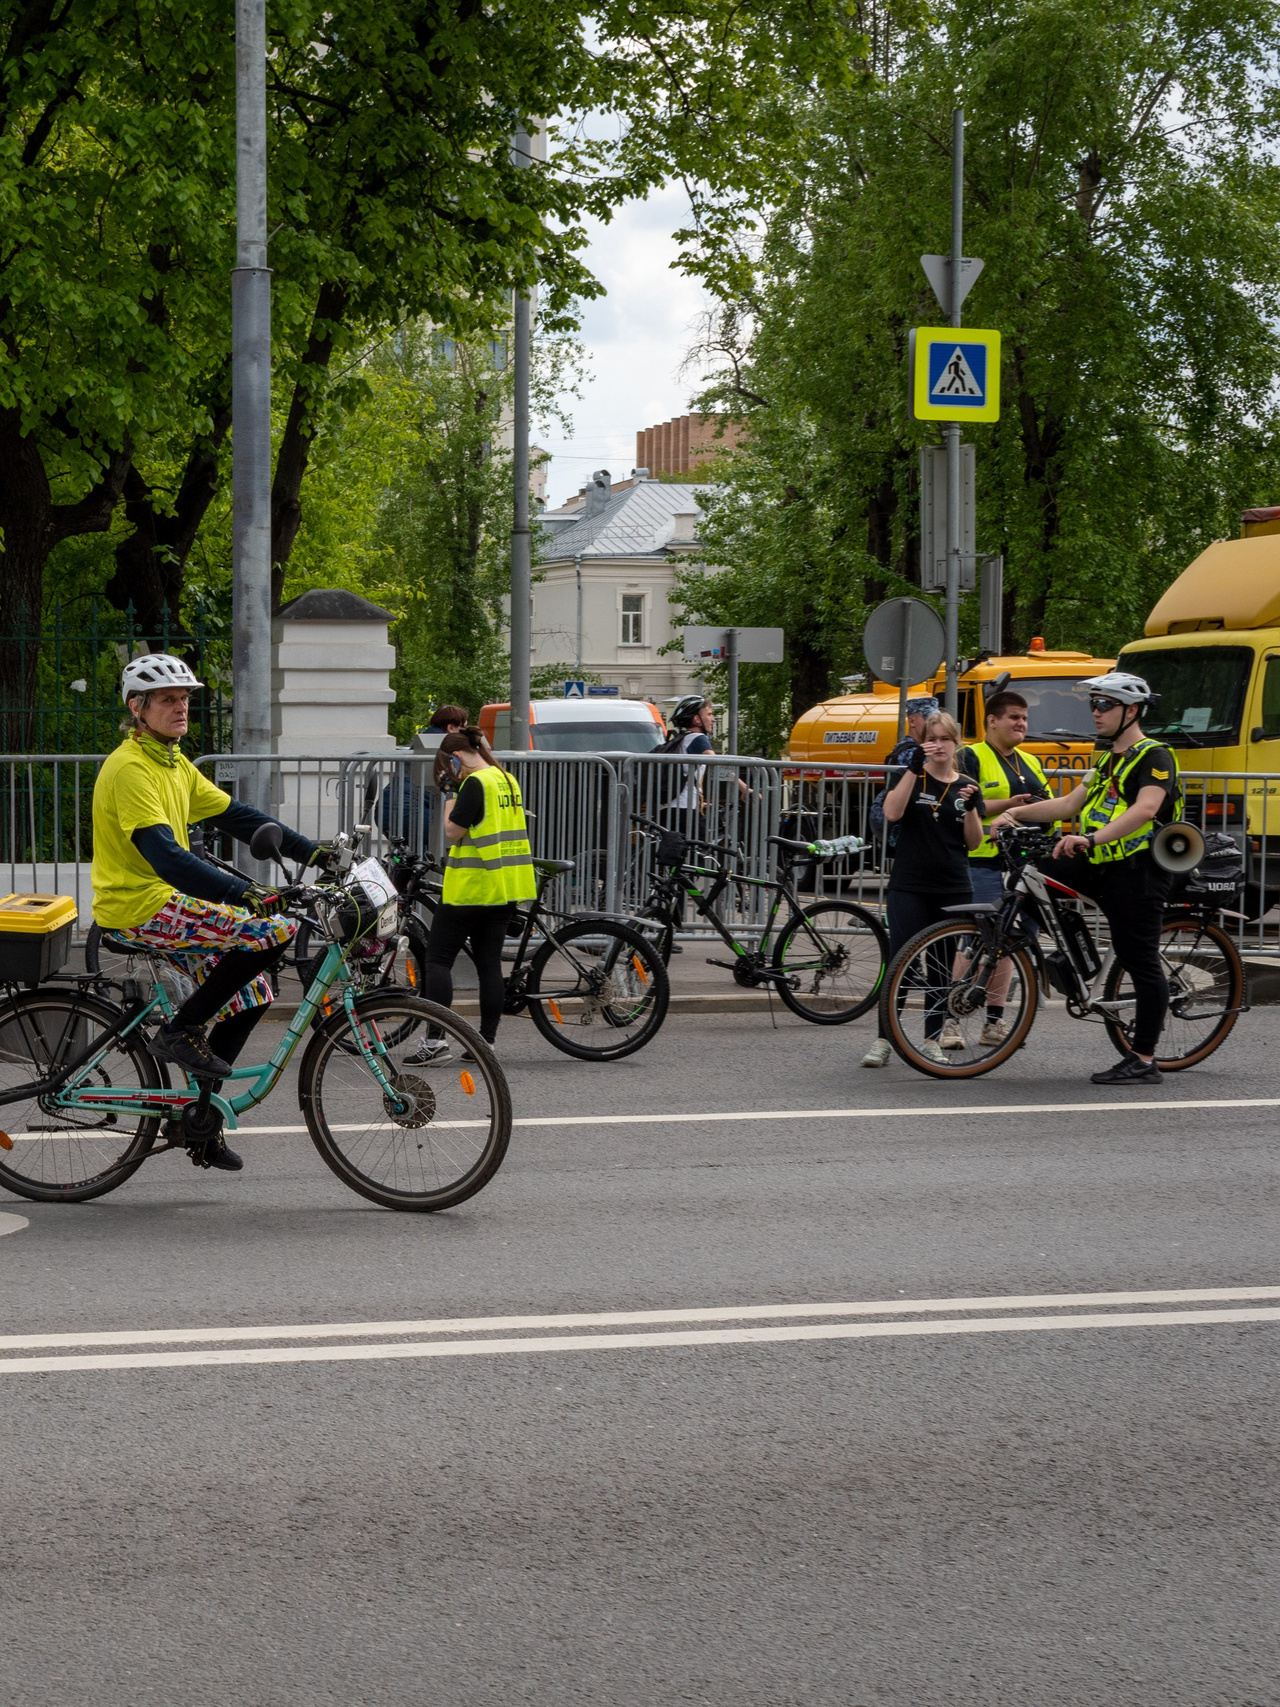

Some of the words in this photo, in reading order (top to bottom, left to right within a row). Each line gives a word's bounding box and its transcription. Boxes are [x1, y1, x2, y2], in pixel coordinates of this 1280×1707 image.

[824, 732, 855, 744] ПИТЬЕВАЯ
[858, 732, 878, 744] ВОДА
[1208, 881, 1236, 892] ЦОВД
[269, 975, 327, 1073] STELS
